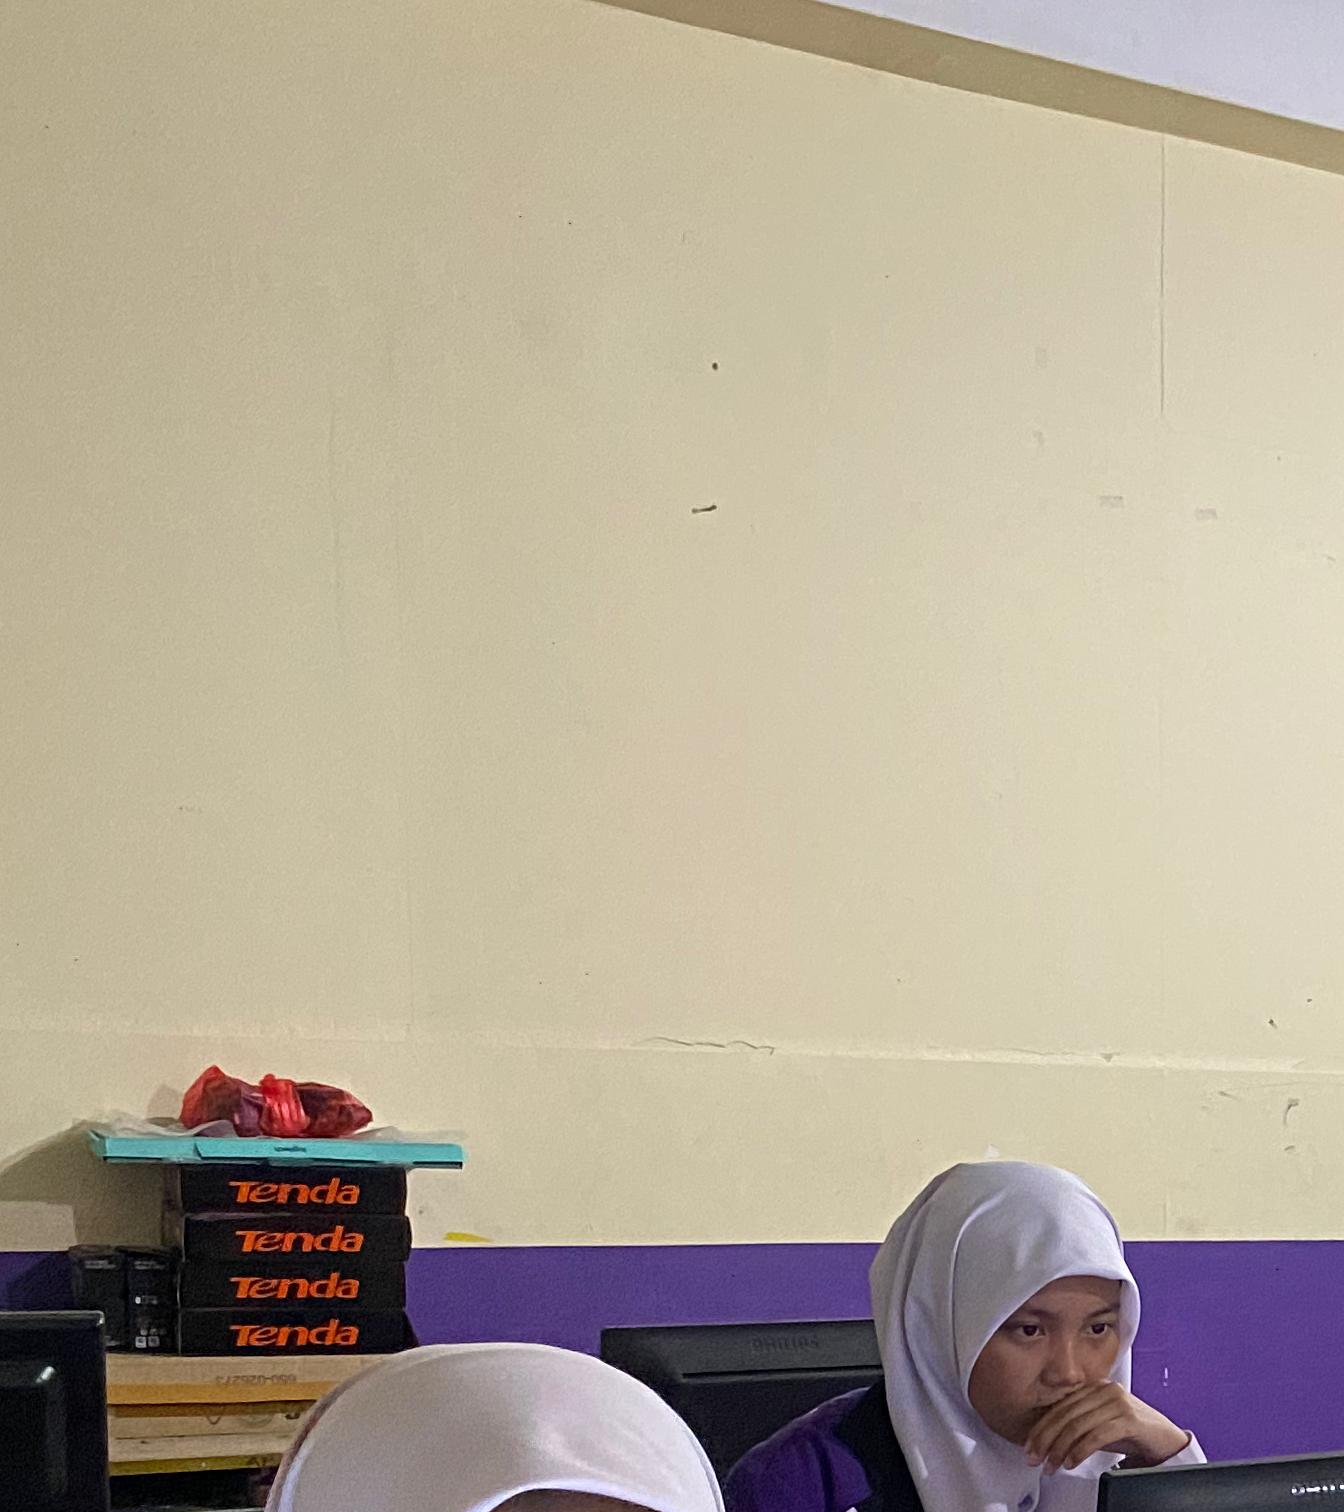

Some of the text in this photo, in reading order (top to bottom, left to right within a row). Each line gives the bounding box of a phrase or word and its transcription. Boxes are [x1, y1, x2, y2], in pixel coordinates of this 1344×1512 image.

[229, 1177, 361, 1205] Tenda
[235, 1225, 365, 1253] Tenda
[229, 1271, 361, 1299] Tenda
[229, 1318, 361, 1347] Tenda
